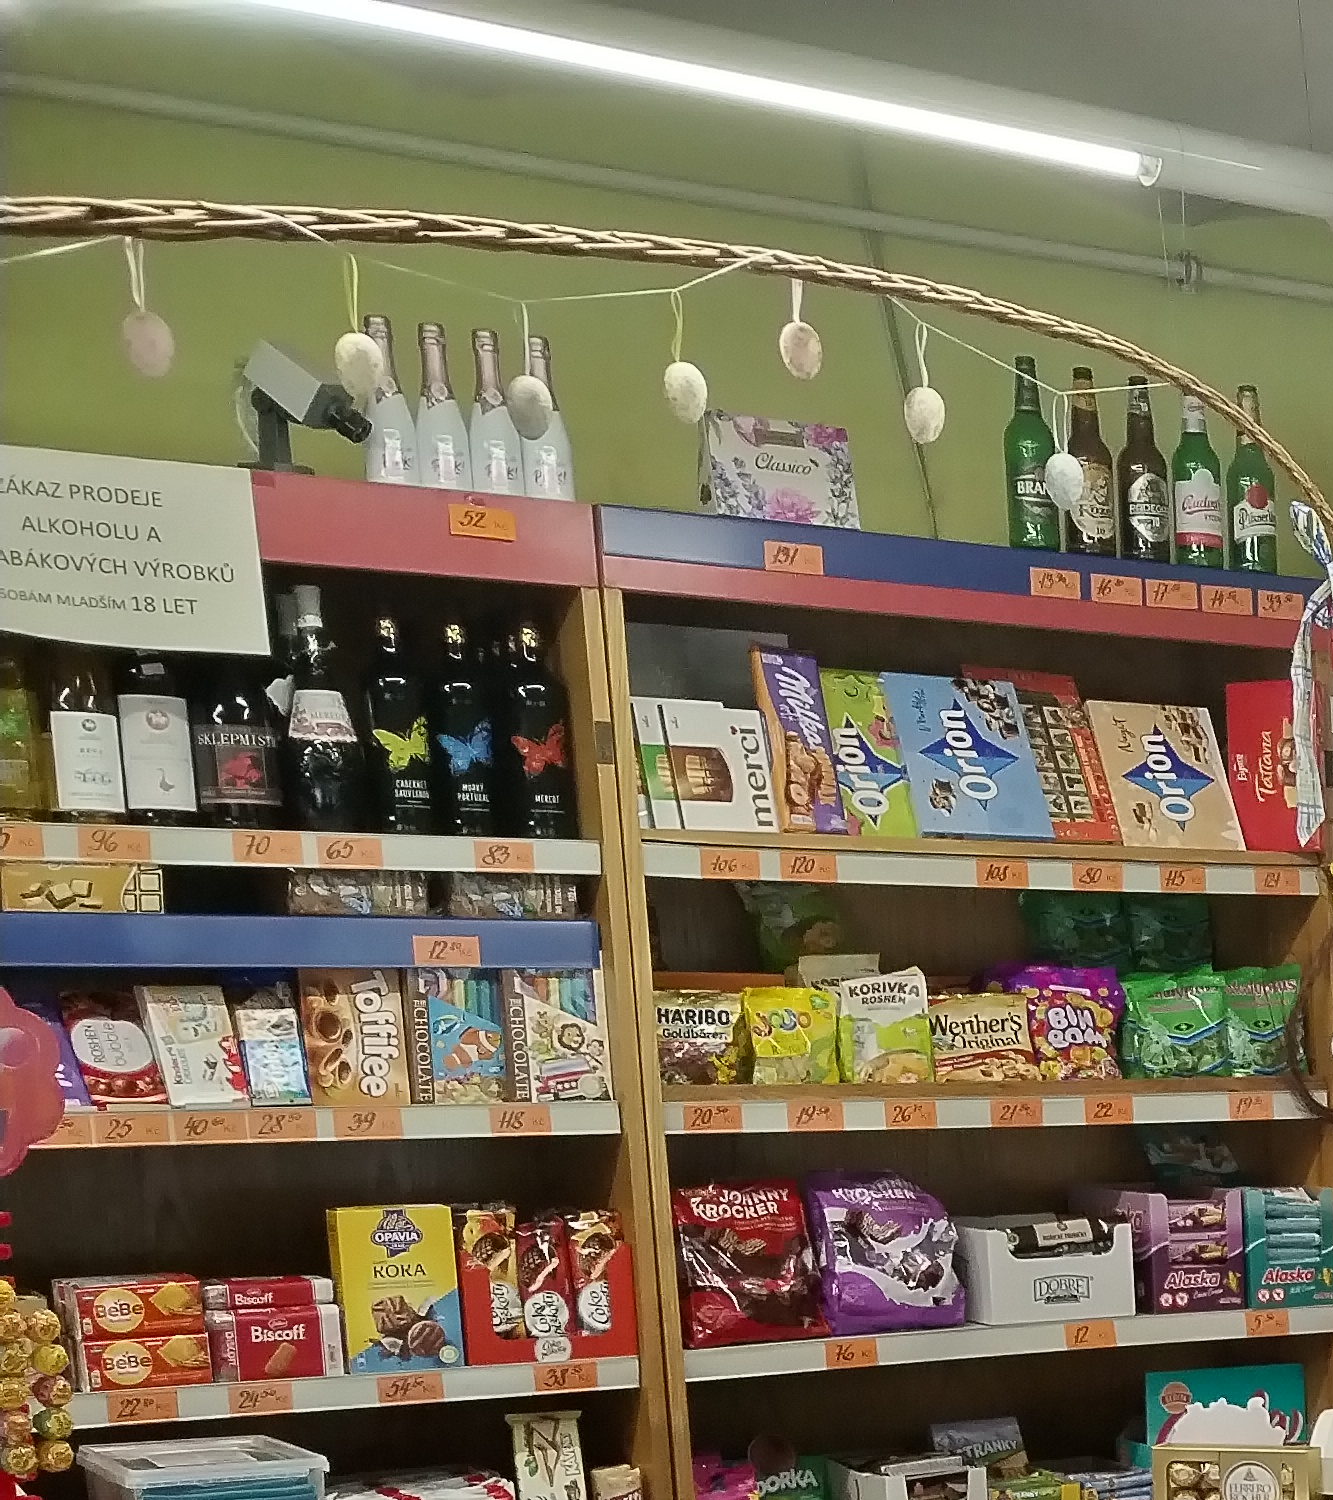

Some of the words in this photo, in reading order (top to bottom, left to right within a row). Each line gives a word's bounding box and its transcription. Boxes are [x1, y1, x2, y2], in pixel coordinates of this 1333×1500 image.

[69, 483, 163, 508] PRODEJE
[22, 516, 139, 541] ALKOHOLU
[147, 526, 162, 543] A
[134, 558, 235, 583] VÝROBKŮ
[132, 597, 156, 614] 18
[163, 599, 198, 615] LET
[736, 726, 775, 828] merci
[656, 1007, 731, 1027] HARIBO
[350, 969, 400, 1098] Toffifee
[718, 1188, 790, 1205] JOHNNY
[374, 1231, 420, 1244] OPAVIA
[1164, 1270, 1221, 1289] Alaska
[1263, 1267, 1316, 1284] Alaska
[235, 1291, 274, 1306] Biscoff
[250, 1323, 307, 1343] Biscoff
